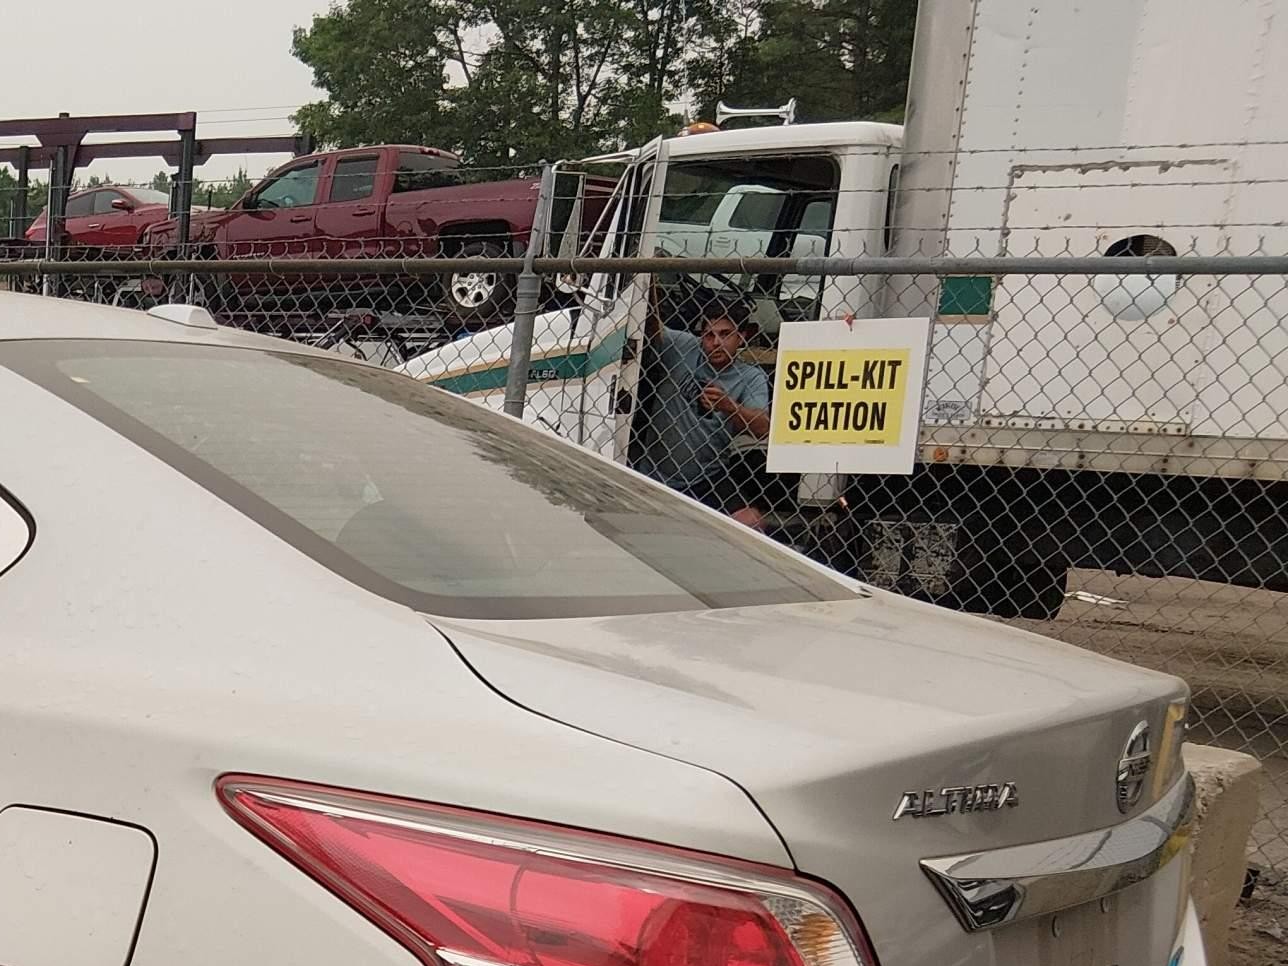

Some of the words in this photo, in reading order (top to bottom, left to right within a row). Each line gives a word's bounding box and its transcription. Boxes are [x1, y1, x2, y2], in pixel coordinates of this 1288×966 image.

[785, 360, 902, 390] SPILL-KIT
[788, 401, 887, 431] STATION
[892, 782, 1019, 820] ALTIMA
